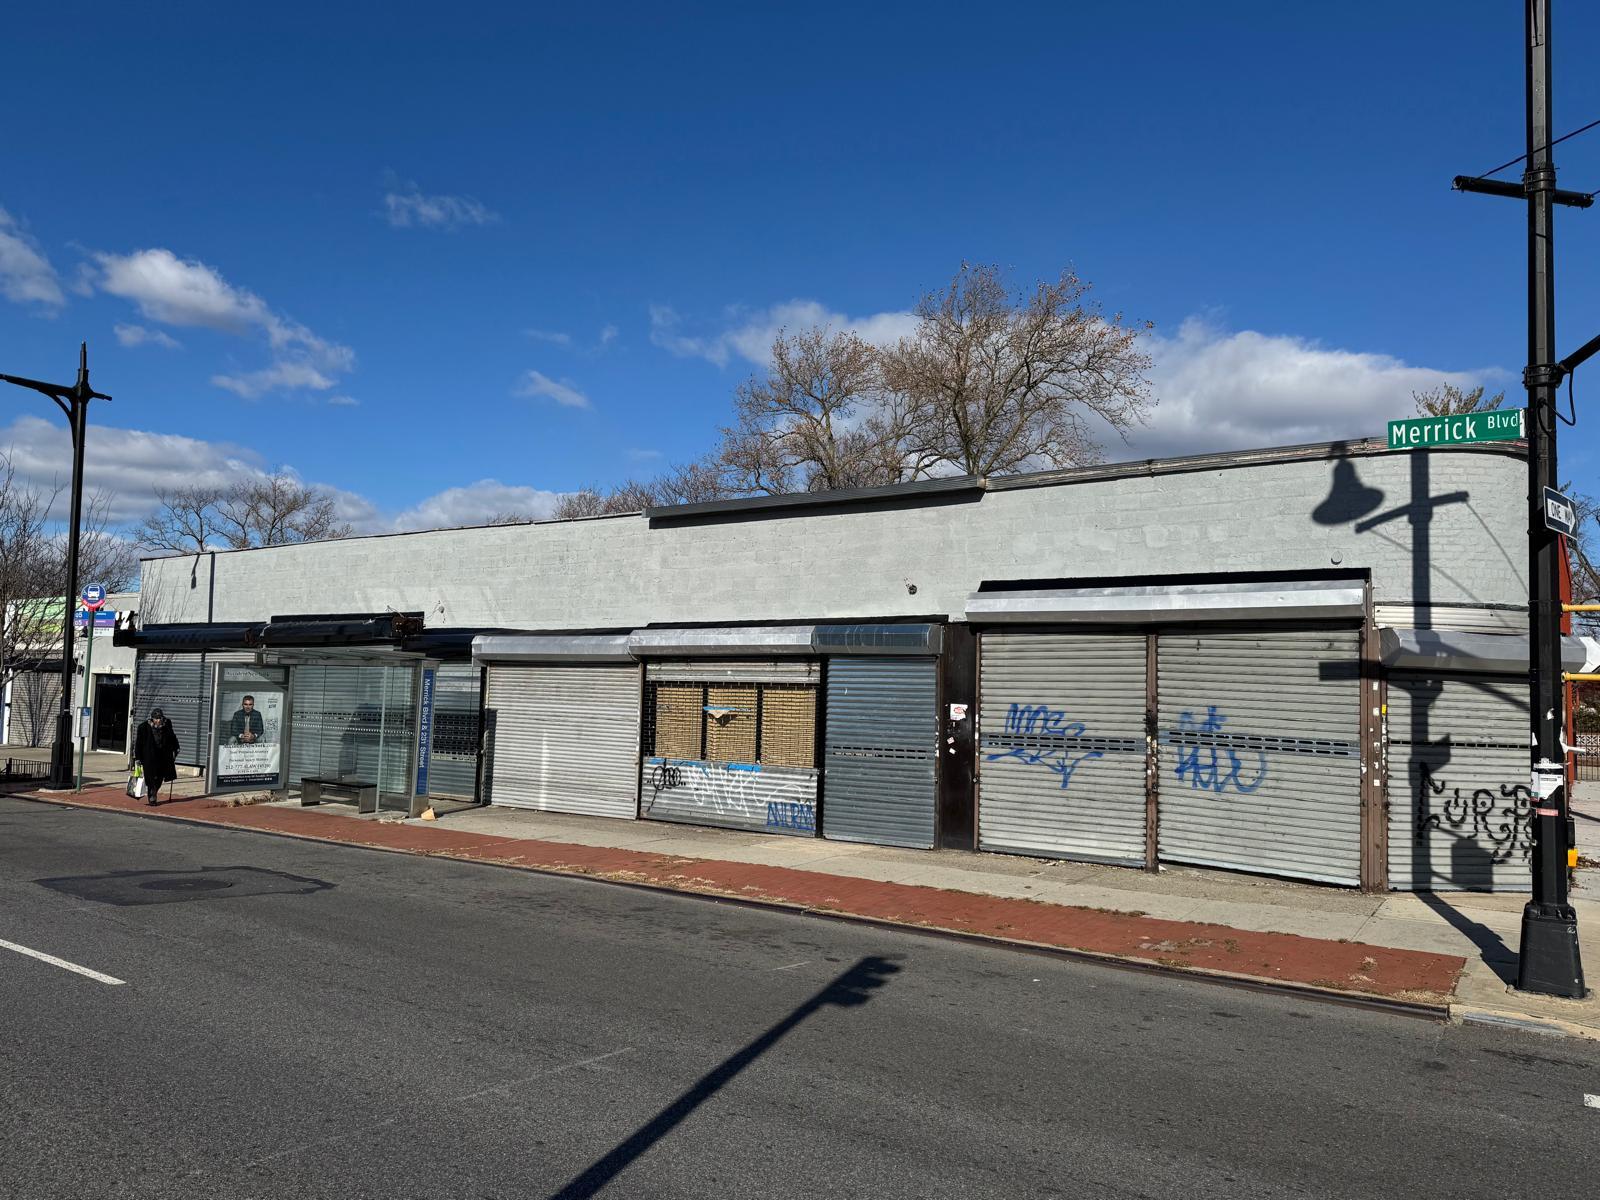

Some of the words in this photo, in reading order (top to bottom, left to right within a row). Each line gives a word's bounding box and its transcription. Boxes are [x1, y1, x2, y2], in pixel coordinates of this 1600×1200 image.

[1392, 417, 1477, 445] Merrick
[1487, 412, 1519, 429] Blvd
[423, 679, 431, 705] Merrick
